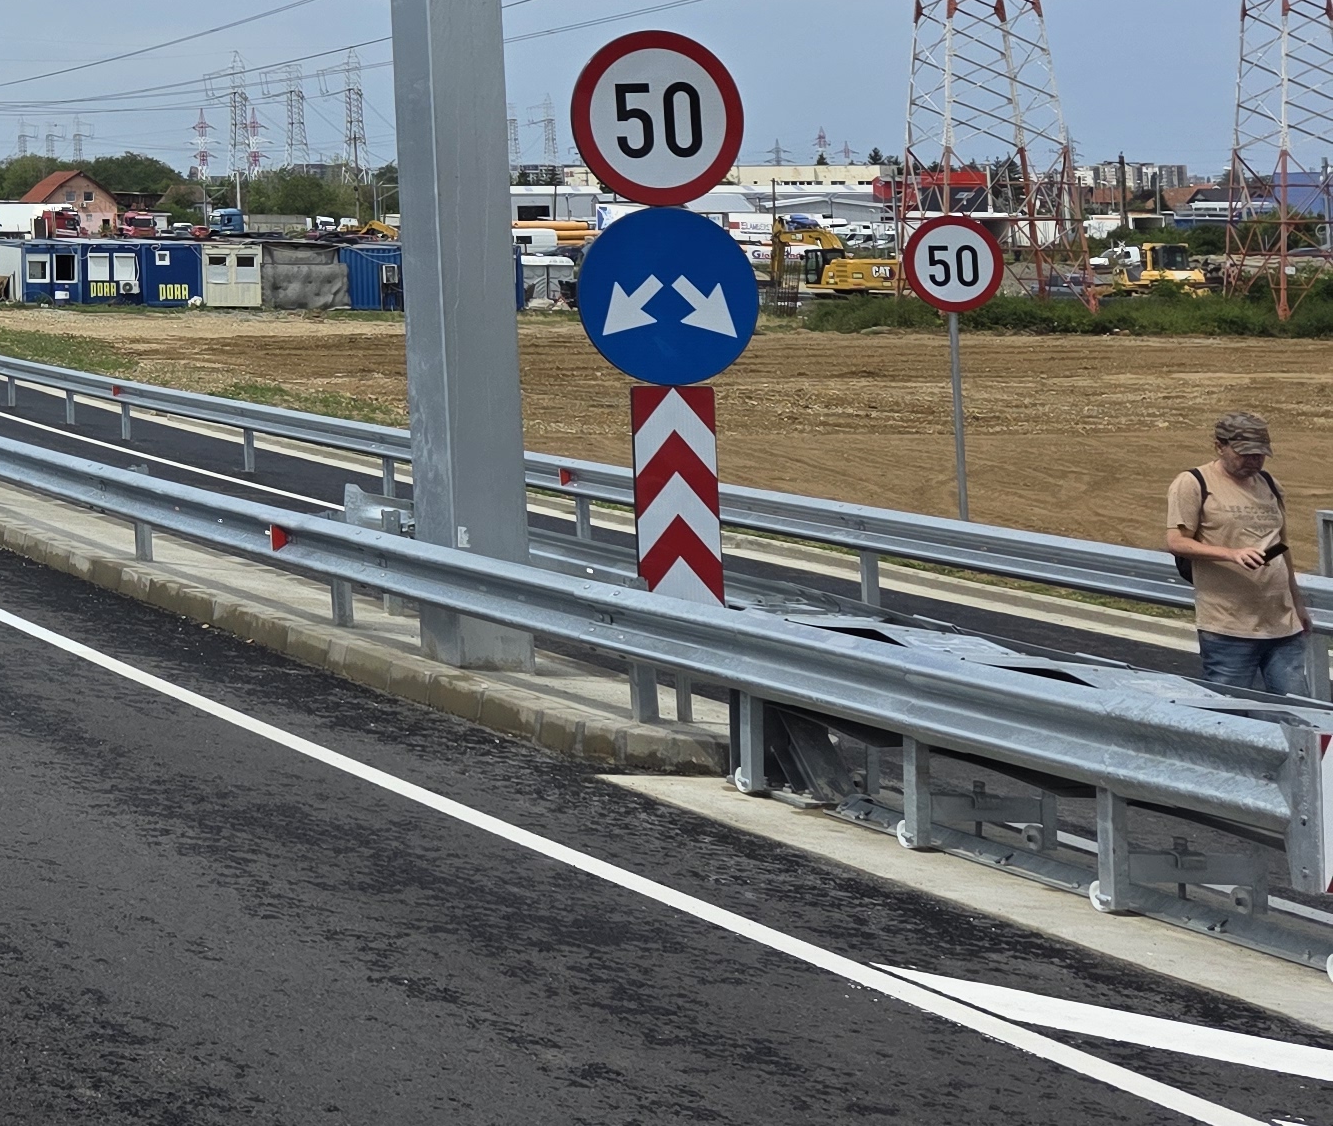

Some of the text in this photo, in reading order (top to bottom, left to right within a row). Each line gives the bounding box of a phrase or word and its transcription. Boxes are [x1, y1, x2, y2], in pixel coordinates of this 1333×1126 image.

[614, 81, 703, 158] 50
[872, 266, 891, 278] CAT
[928, 244, 979, 287] 50
